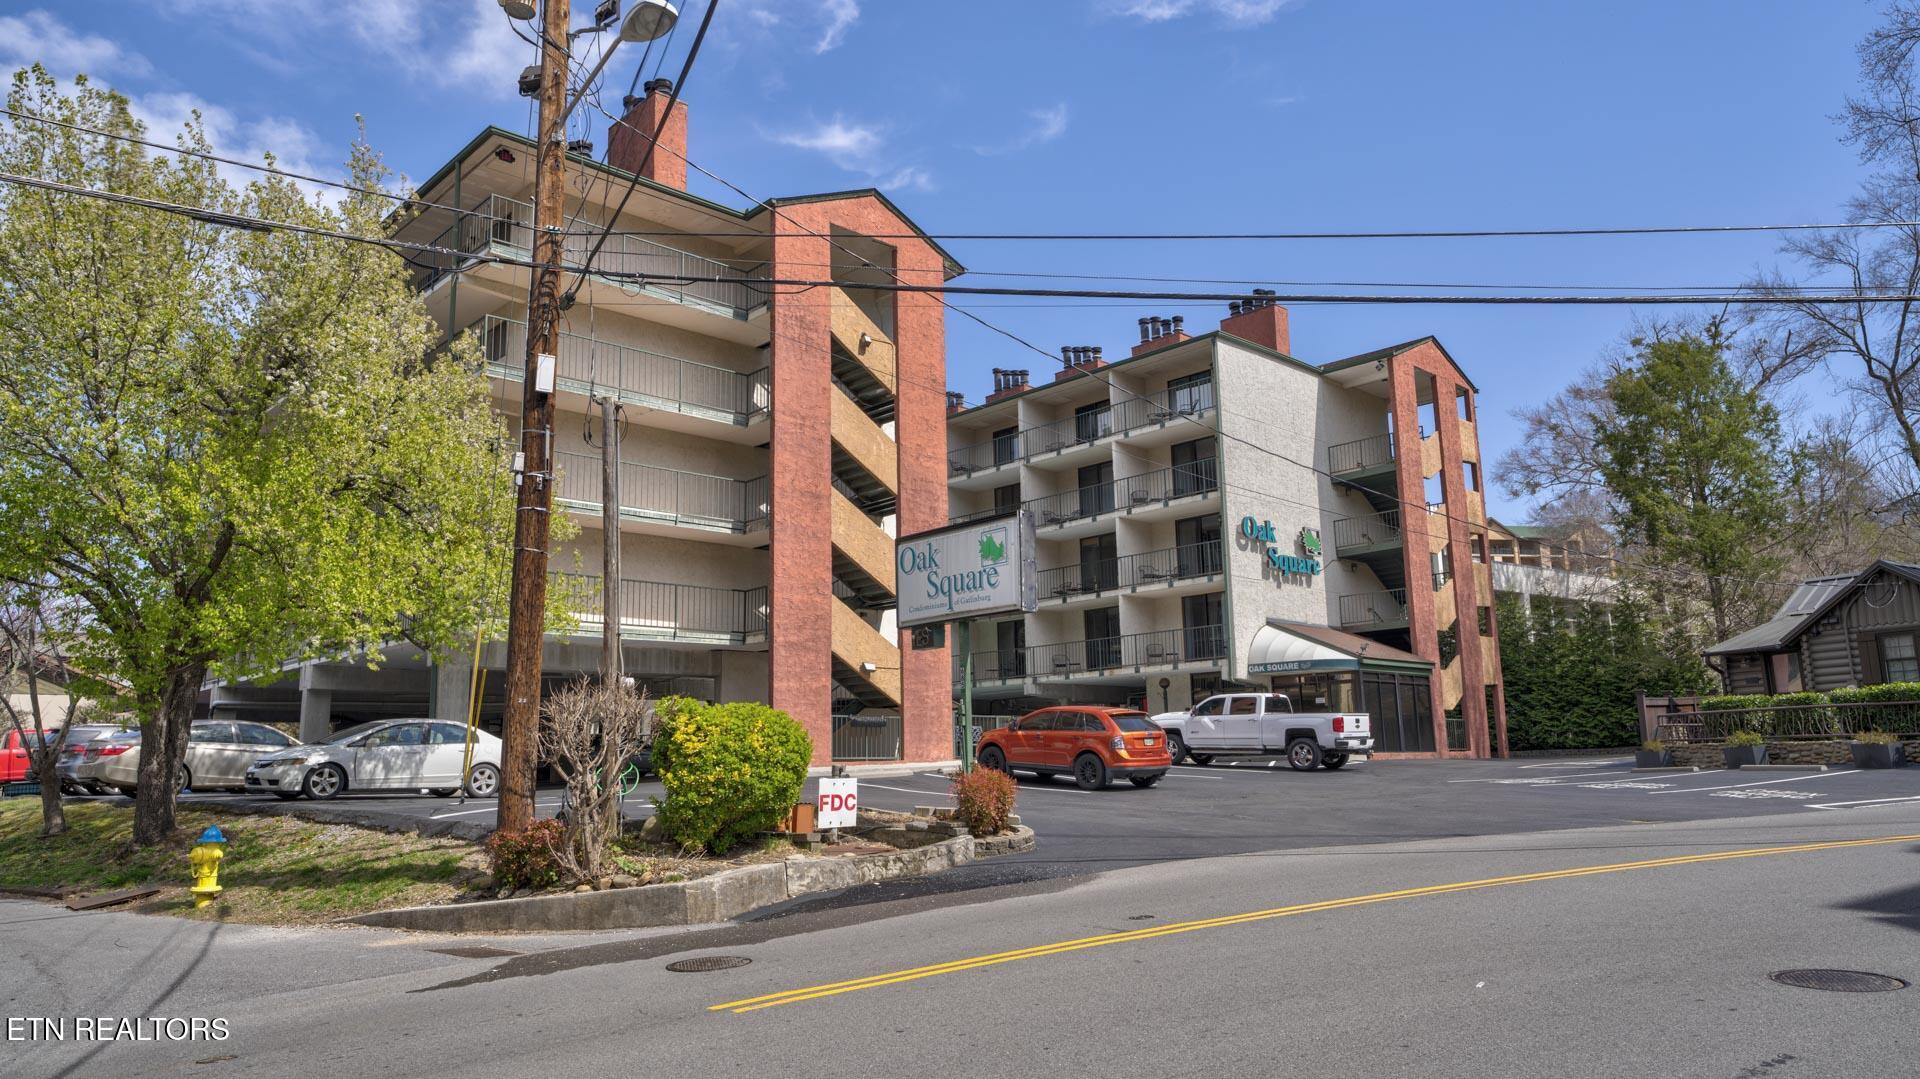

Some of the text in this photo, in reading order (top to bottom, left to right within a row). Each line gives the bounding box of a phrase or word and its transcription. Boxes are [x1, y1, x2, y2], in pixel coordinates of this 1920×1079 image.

[1241, 515, 1276, 543] Oak
[900, 543, 939, 576] Oak
[1267, 547, 1321, 577] Square
[927, 567, 1000, 611] Square
[1248, 662, 1299, 673] OAK SQUARE
[819, 794, 857, 812] FDC
